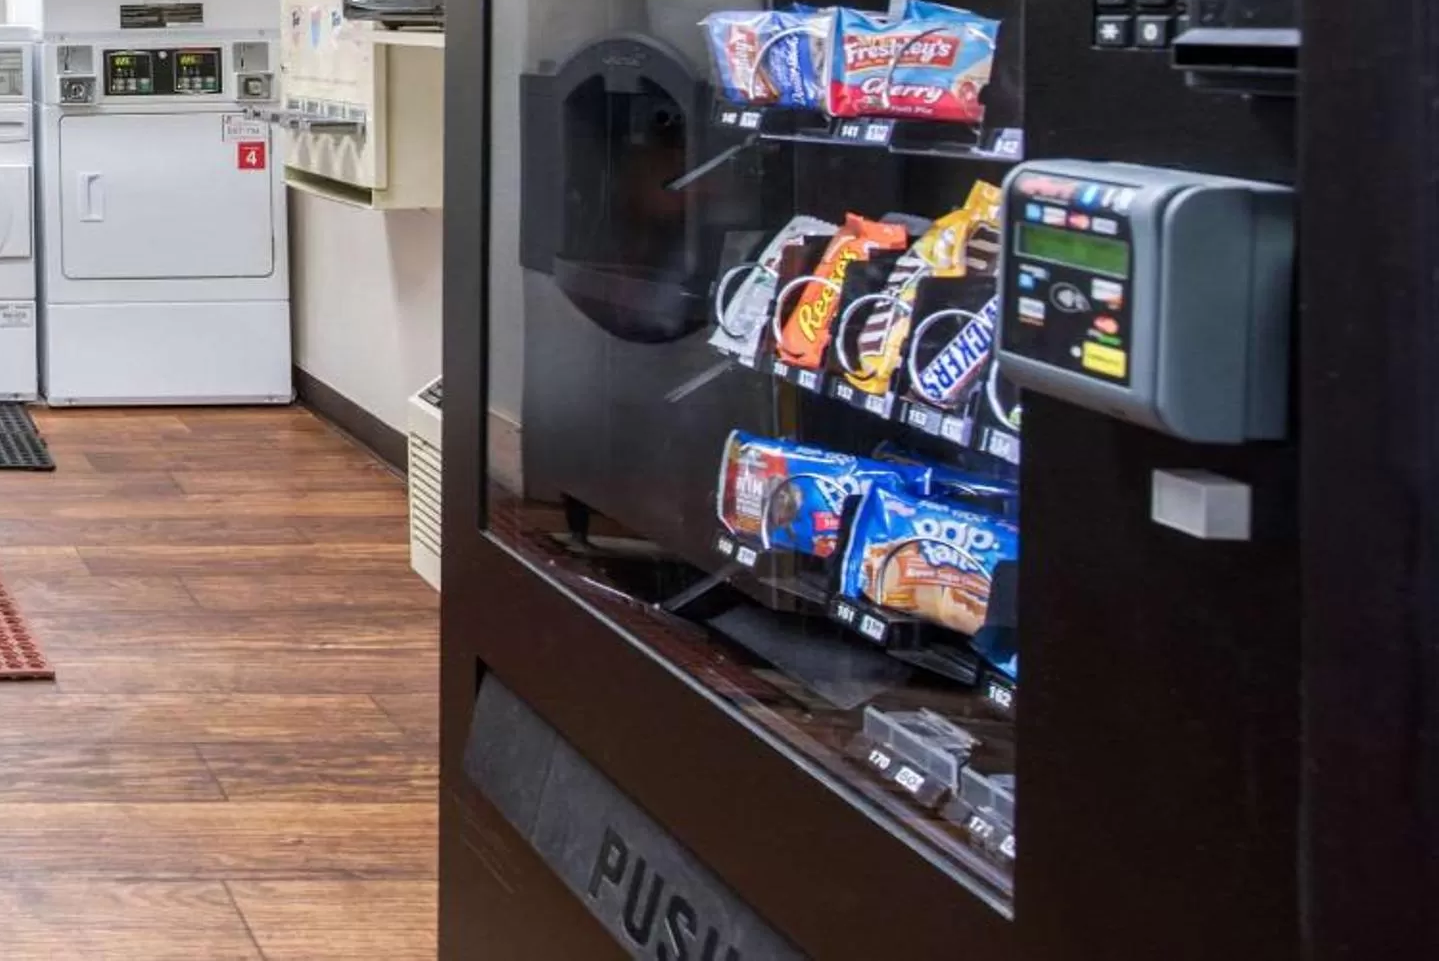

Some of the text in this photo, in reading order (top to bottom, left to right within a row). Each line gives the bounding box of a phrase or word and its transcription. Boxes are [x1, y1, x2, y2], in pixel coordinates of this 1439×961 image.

[1144, 23, 1158, 40] 0
[245, 151, 258, 165] 4
[920, 298, 998, 398] ICKERS
